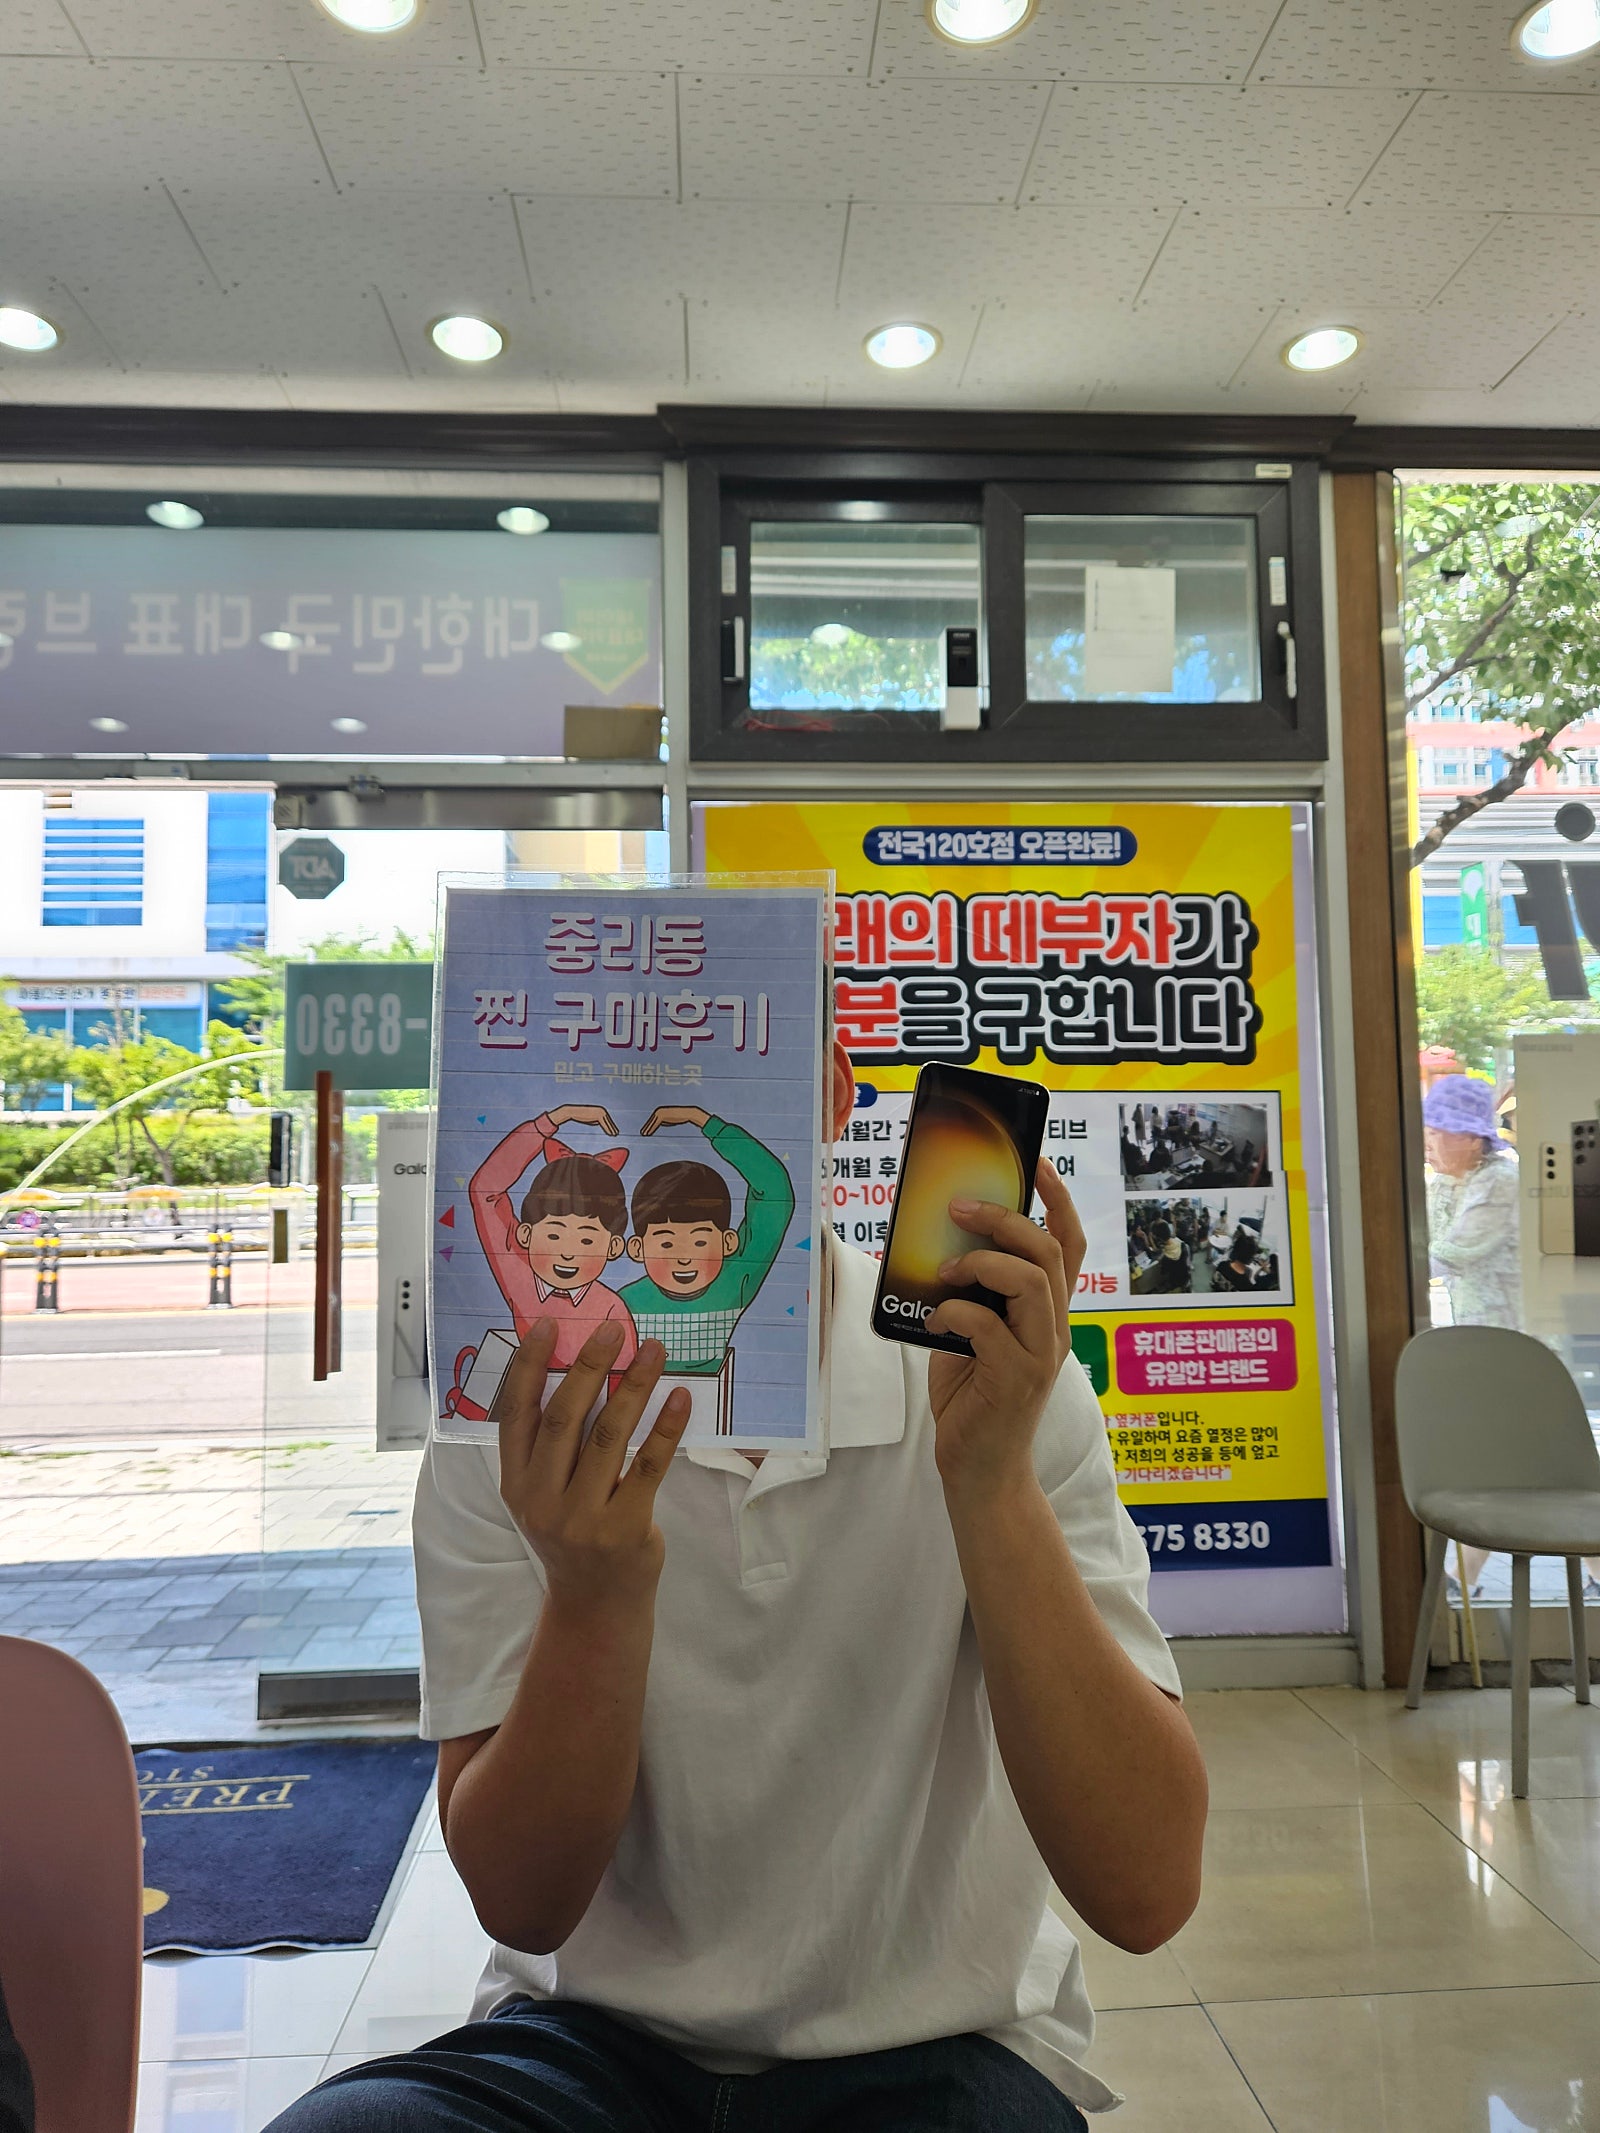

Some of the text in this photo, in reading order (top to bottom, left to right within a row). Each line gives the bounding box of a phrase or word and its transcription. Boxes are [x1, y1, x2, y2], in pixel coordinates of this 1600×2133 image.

[877, 830, 1122, 861] 전국120호점 오픈완료!
[543, 911, 707, 977] 중리동
[824, 894, 1250, 969] 래의 떼부자가
[472, 987, 770, 1056] 찐 구매후기
[834, 974, 1253, 1052] 분을 구합니다
[554, 1061, 703, 1086] 믿고 구매하는곳
[1048, 1119, 1088, 1140] 티브
[1074, 1272, 1118, 1294] 가능
[1133, 1327, 1278, 1356] 휴대폰판매점의
[1145, 1358, 1269, 1388] 유일한 브랜드
[1117, 1430, 1172, 1446] 유일하며
[1175, 1429, 1203, 1444] 요즘
[1207, 1427, 1248, 1444] 열정은
[1251, 1426, 1279, 1442] 많이
[1125, 1448, 1167, 1464] 저희의
[1172, 1447, 1214, 1463] 성공을
[1219, 1445, 1247, 1462] 등에
[1194, 1521, 1270, 1550] 8330
